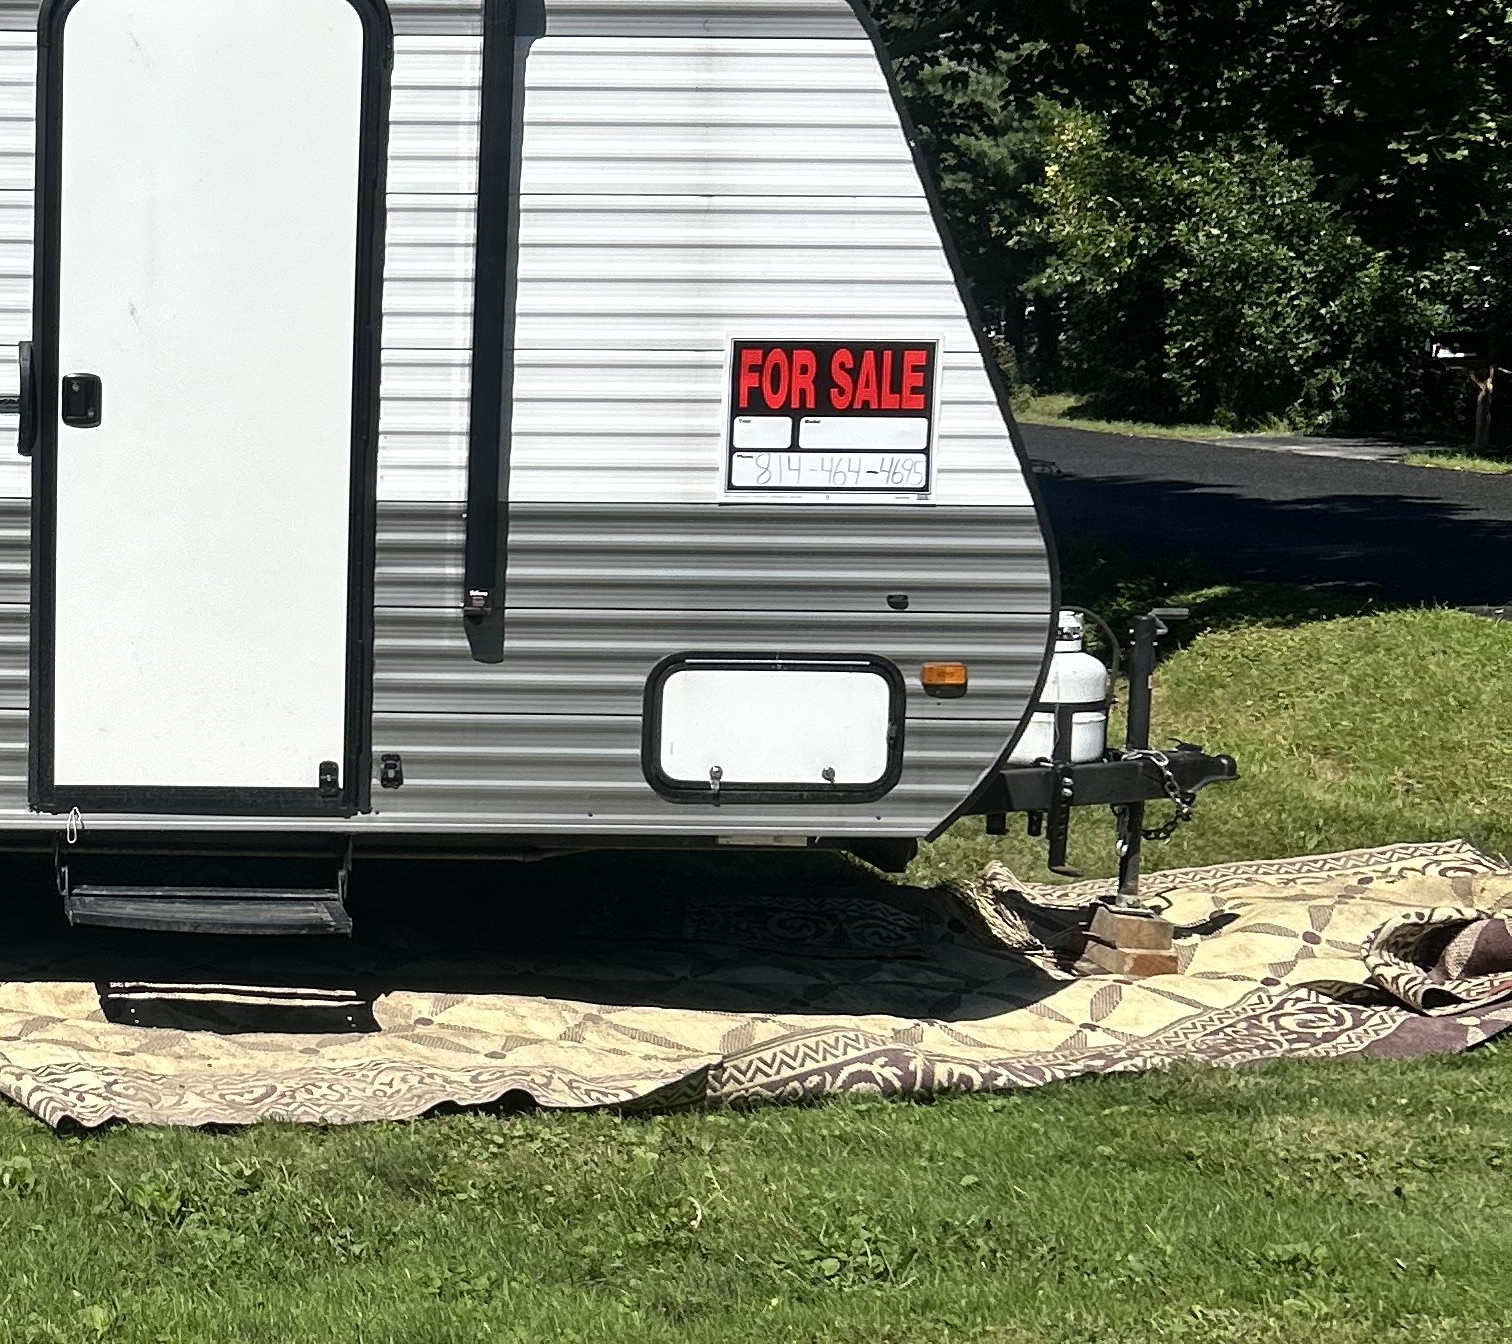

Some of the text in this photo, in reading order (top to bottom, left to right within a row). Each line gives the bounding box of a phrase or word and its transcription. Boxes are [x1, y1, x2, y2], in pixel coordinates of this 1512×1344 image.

[738, 347, 928, 410] FOR SALE
[755, 453, 924, 486] 814-464-4695
